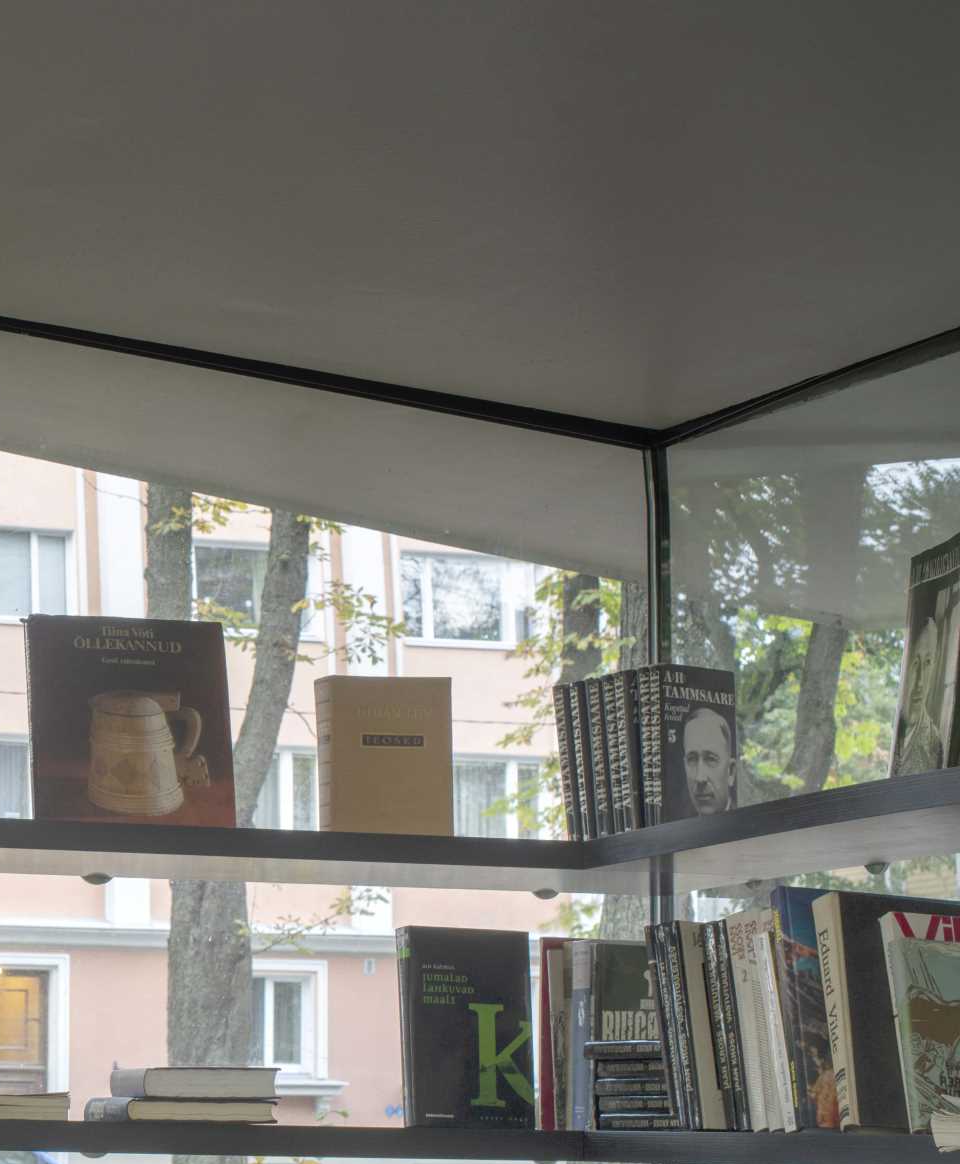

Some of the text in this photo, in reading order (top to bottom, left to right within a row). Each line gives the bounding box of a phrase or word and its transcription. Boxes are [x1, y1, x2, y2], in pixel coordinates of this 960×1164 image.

[73, 635, 182, 654] ÕLLEKANNUD
[663, 686, 735, 706] TAMMSAARE
[668, 729, 677, 743] 5
[818, 929, 840, 1054] Eduard Vilde
